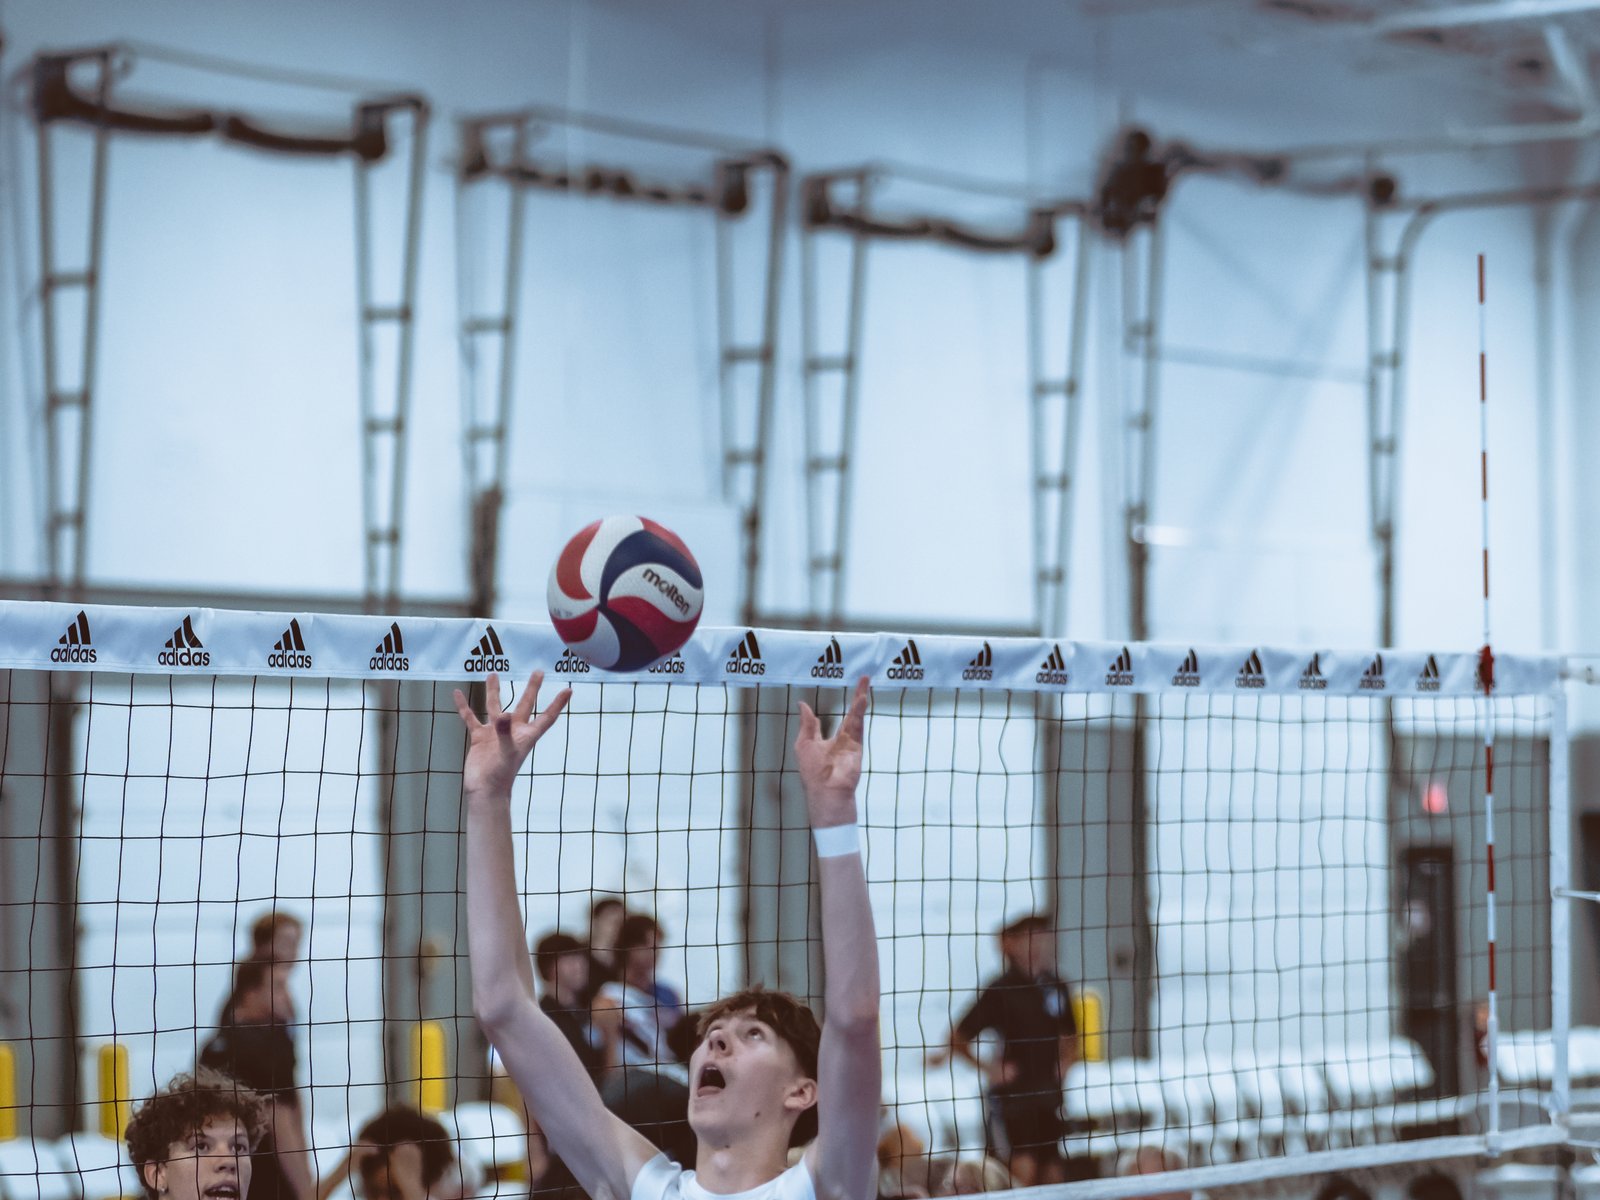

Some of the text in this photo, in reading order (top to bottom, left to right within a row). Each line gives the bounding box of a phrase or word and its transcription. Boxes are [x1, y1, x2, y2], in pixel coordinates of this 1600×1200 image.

[642, 568, 690, 616] molten
[50, 644, 97, 664] adidas
[158, 647, 210, 667] adidas
[267, 649, 312, 669] adidas
[369, 652, 409, 672] adidas
[464, 655, 509, 673] adidas
[554, 656, 590, 673] adidas
[725, 657, 765, 676] adidas
[811, 662, 844, 679] adidas
[887, 663, 924, 681] adidas
[962, 664, 993, 681] adidas
[1036, 668, 1067, 686] adidas
[1105, 671, 1134, 686] adidas
